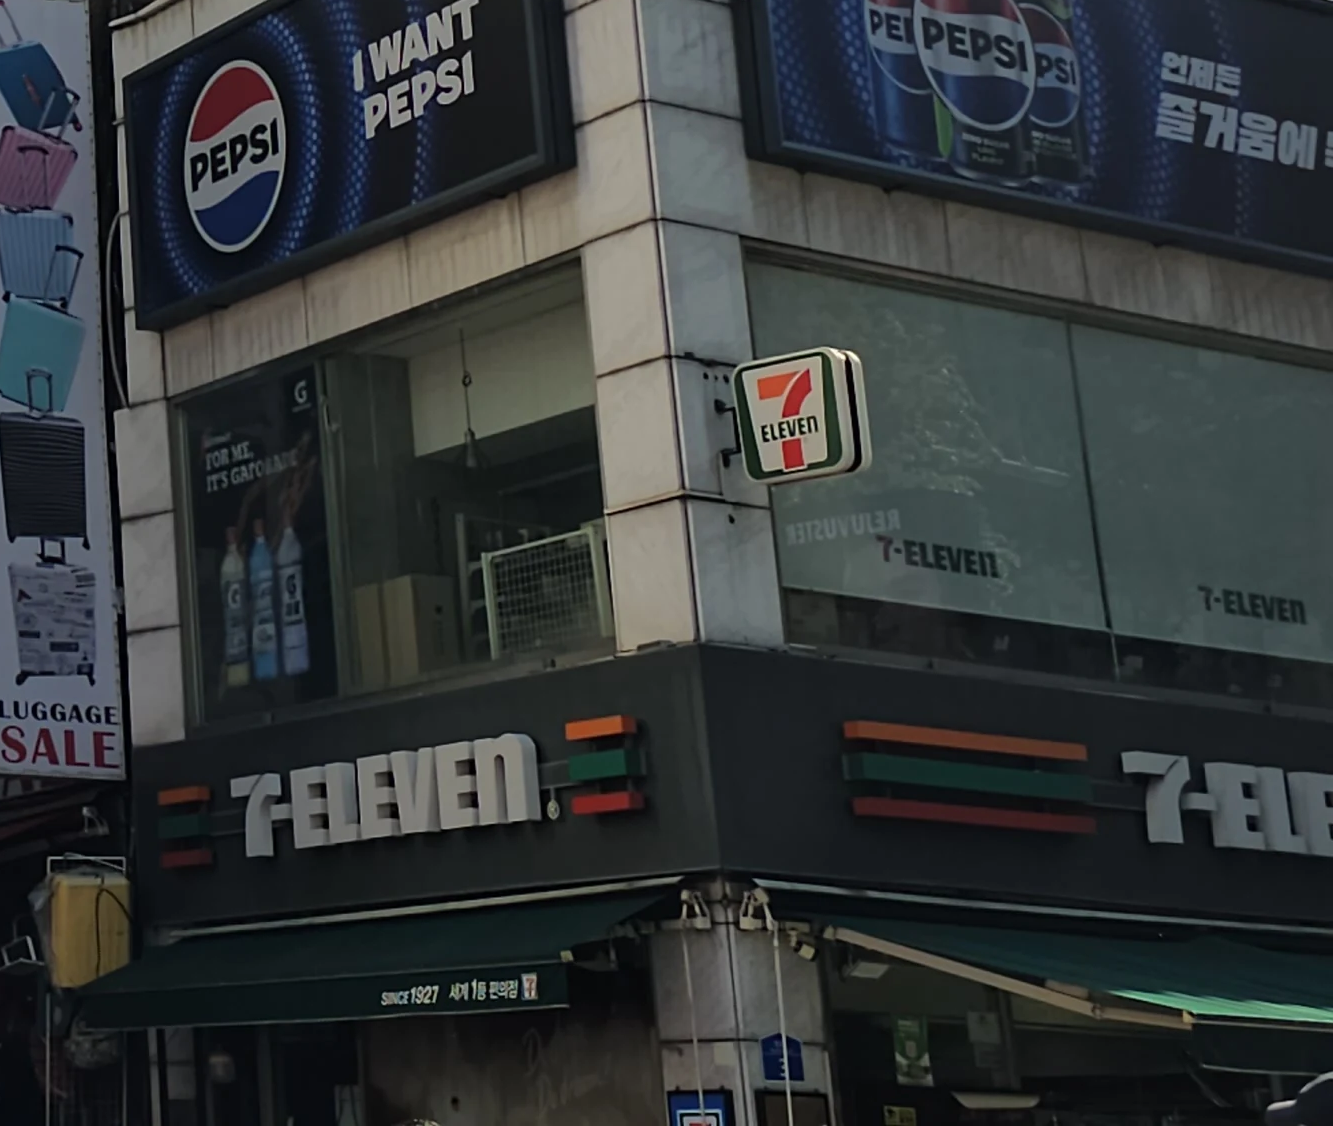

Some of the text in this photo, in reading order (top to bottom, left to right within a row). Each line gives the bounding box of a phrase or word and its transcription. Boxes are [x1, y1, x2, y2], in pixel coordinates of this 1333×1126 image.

[921, 17, 1027, 72] PEPSI
[353, 50, 366, 91] I
[1037, 53, 1076, 85] PSI
[1161, 51, 1241, 96] 언제든
[362, 51, 475, 139] PEPSI
[1155, 92, 1318, 170] 즐거움에
[190, 118, 279, 193] PEPSI
[293, 380, 308, 404] G
[1, 725, 120, 769] SALE
[410, 985, 440, 1005] 1927
